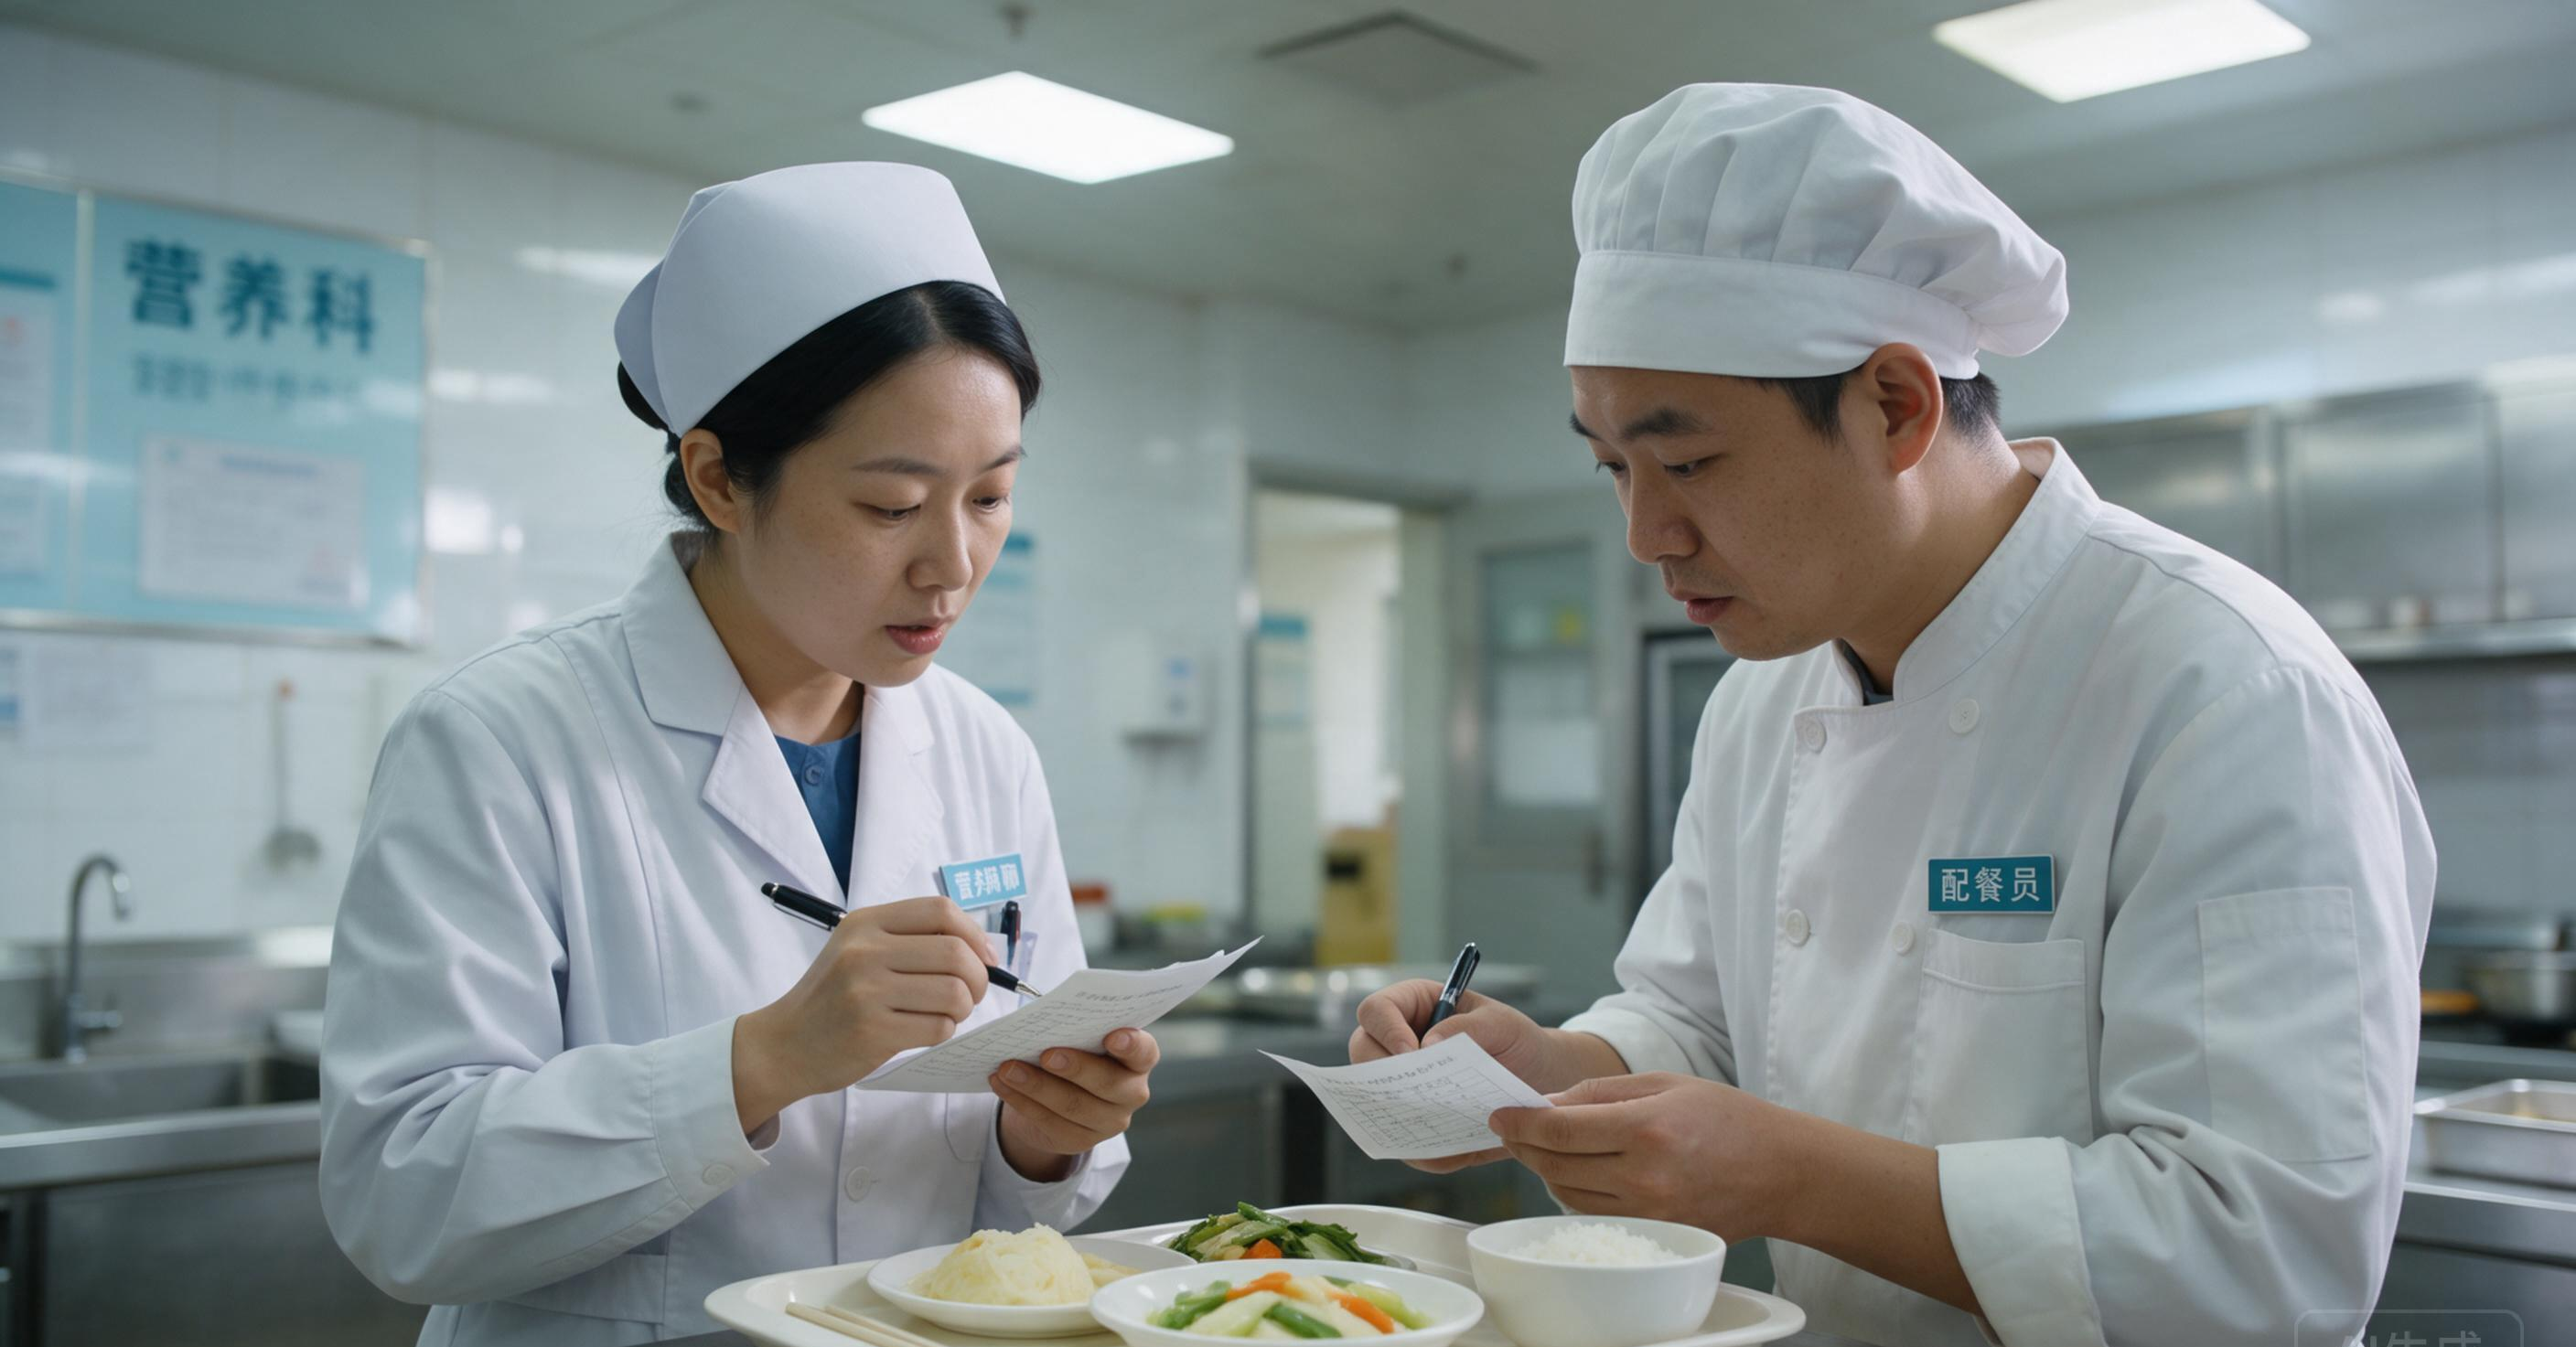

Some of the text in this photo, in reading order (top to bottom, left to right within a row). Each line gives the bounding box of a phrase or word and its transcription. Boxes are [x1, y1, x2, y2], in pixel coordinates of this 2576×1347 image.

[126, 238, 374, 353] 营养科
[1941, 867, 2040, 903] 配餐员
